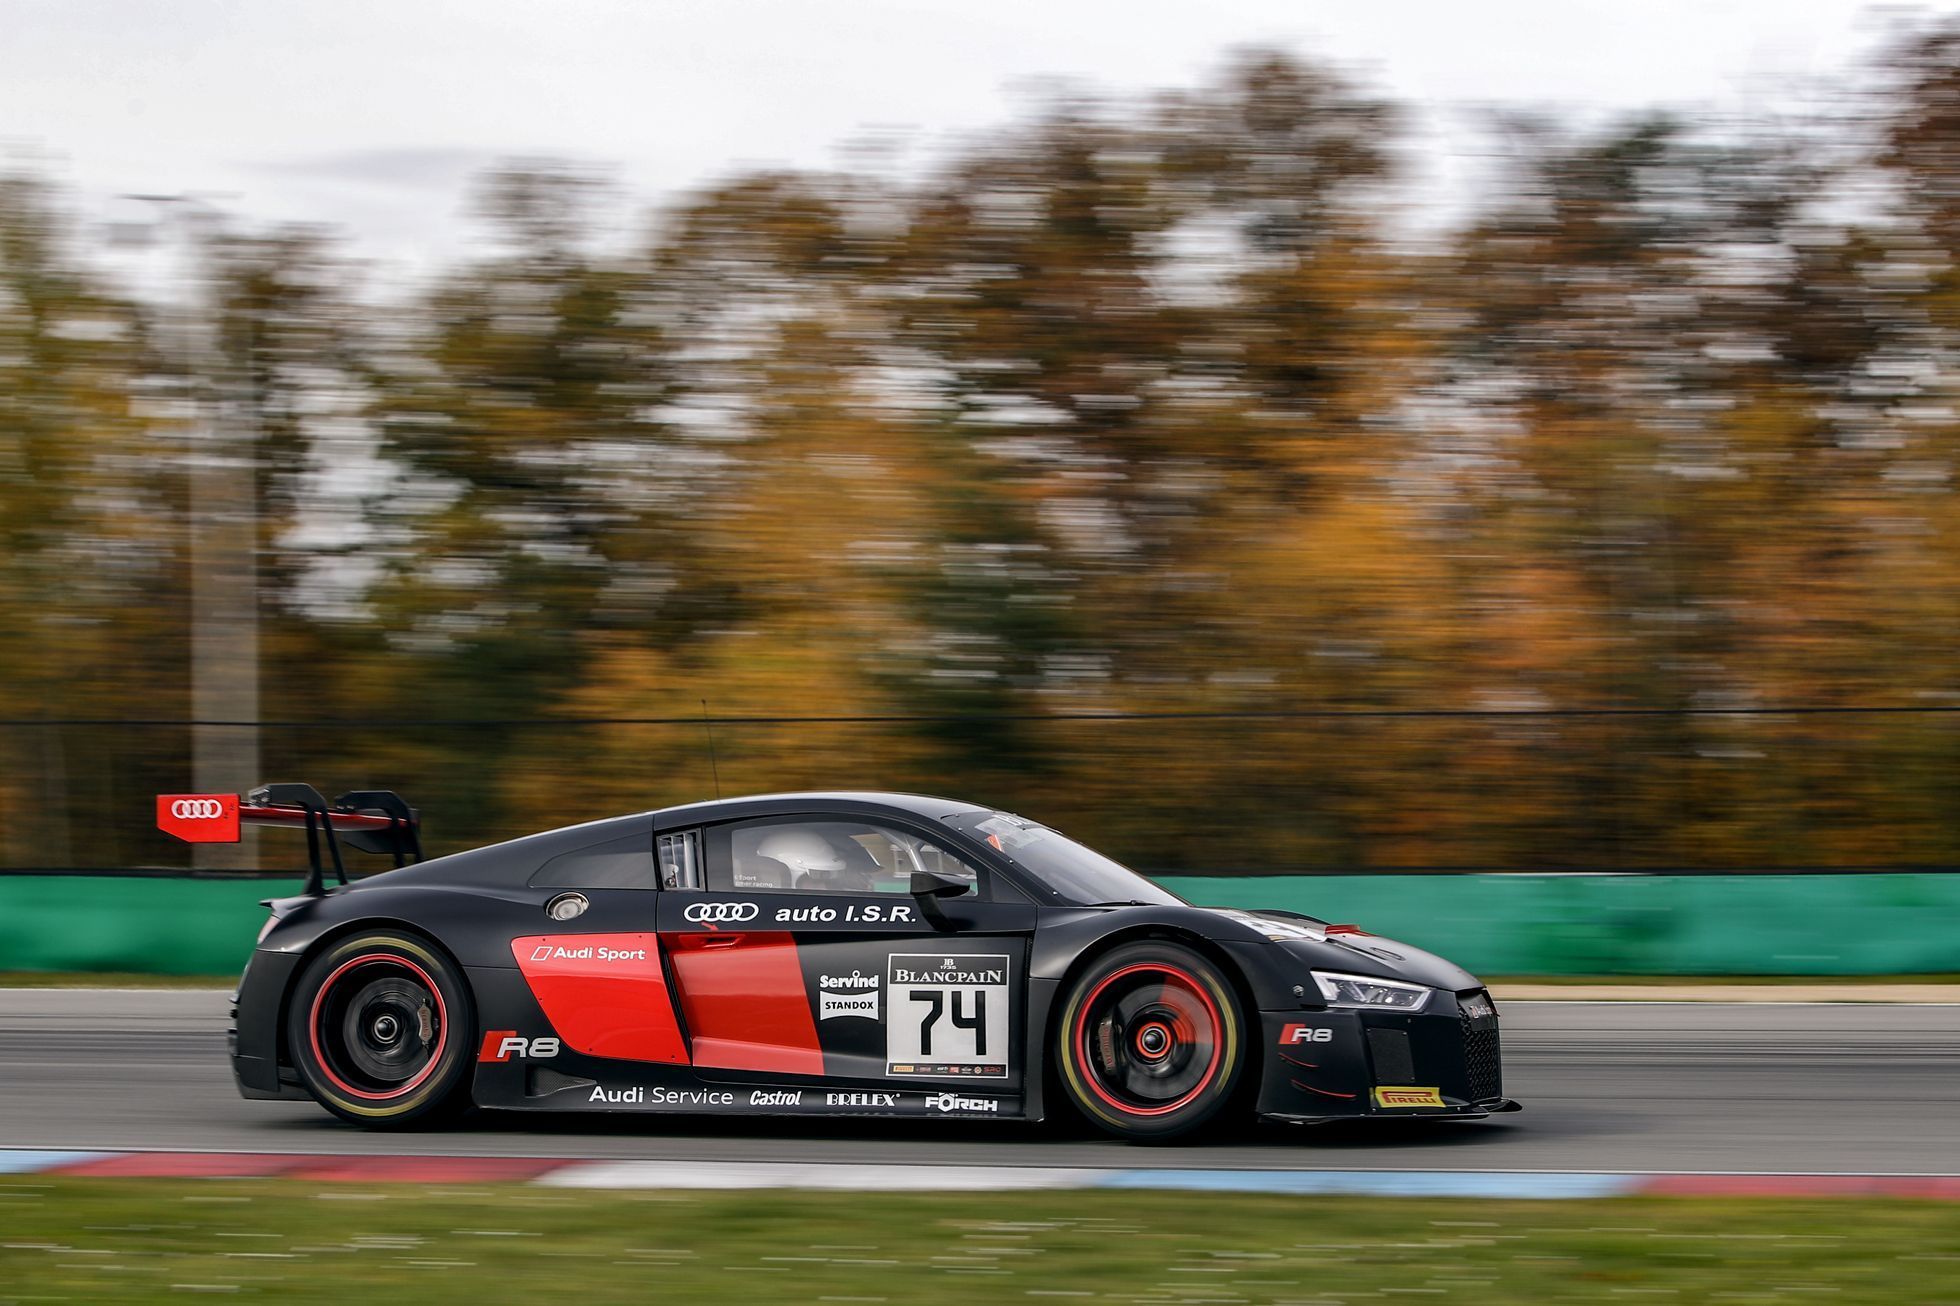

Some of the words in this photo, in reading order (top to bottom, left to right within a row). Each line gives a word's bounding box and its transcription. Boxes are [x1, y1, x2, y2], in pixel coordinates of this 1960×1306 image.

[775, 905, 837, 923] auto
[845, 906, 917, 923] I.S.R.
[553, 946, 593, 960] Audi
[597, 947, 645, 962] Sport
[819, 969, 879, 989] Servind
[895, 969, 1003, 983] BLANCPAIN
[825, 1001, 874, 1011] STANDOX
[908, 990, 987, 1056] 74
[1290, 1028, 1334, 1043] R8
[496, 1037, 561, 1058] R8
[588, 1085, 645, 1103] Audi
[651, 1087, 735, 1105] Service
[749, 1089, 802, 1106] Castrol
[924, 1091, 999, 1113] FÖRCH
[1381, 1090, 1437, 1105] PIRELLI
